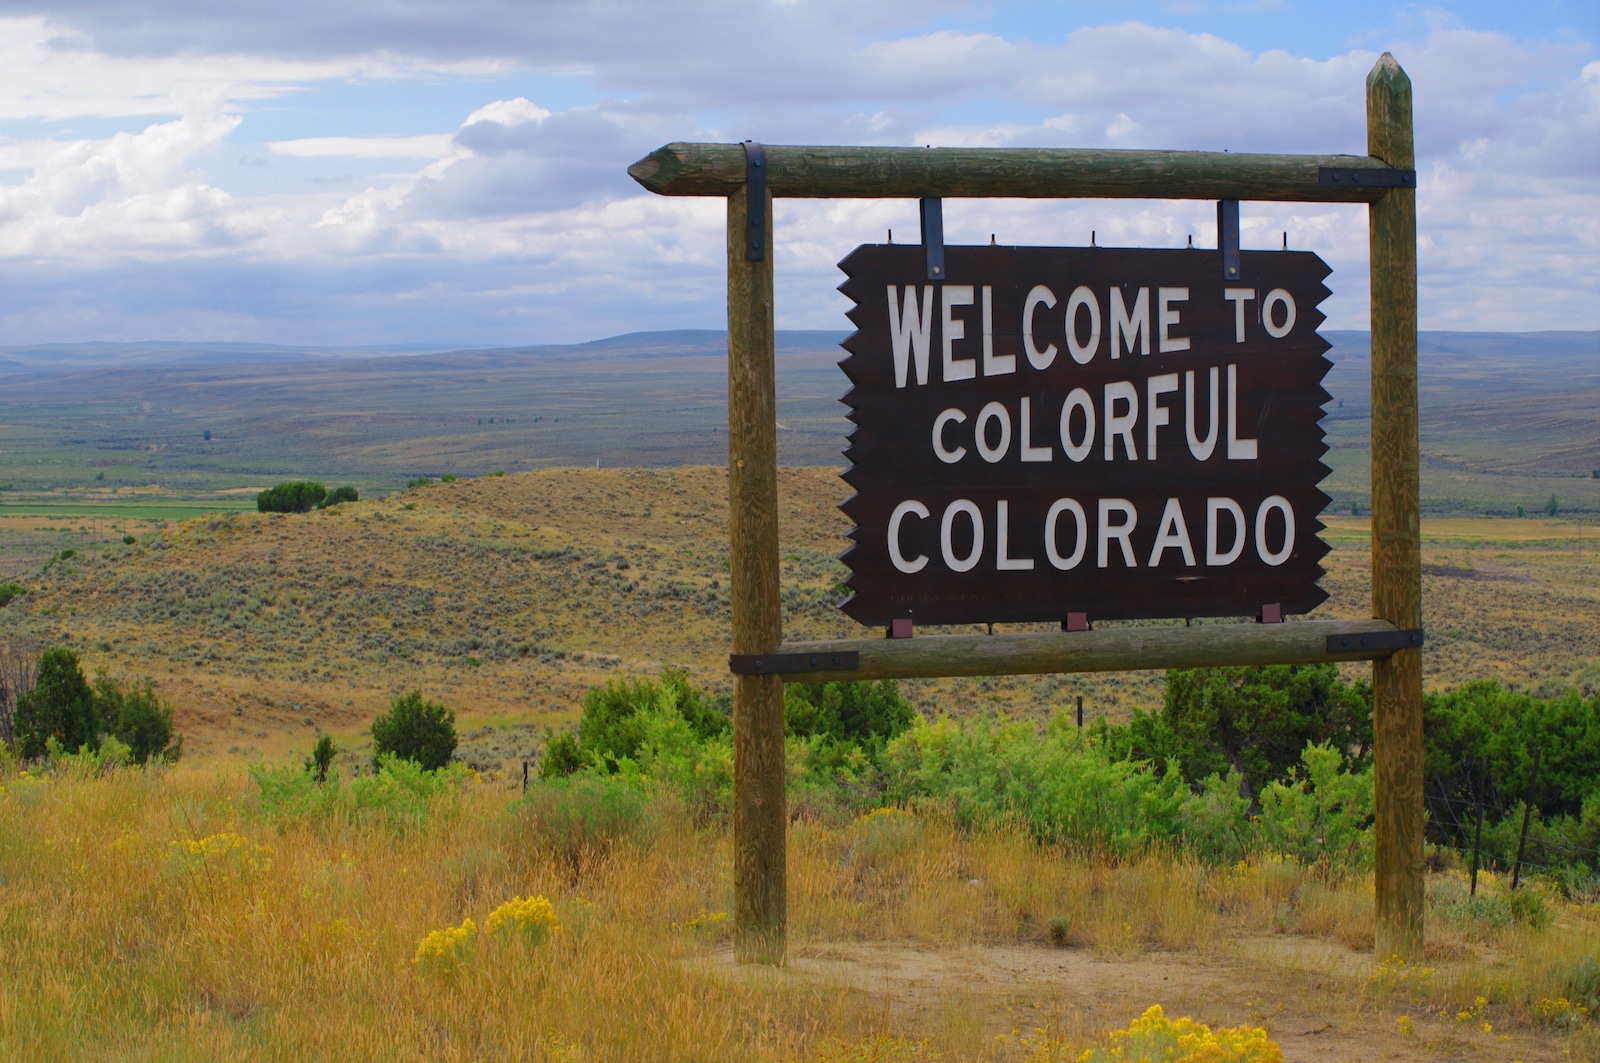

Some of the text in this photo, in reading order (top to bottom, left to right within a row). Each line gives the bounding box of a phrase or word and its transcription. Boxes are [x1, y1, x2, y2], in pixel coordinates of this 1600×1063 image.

[887, 285, 1297, 388] WELCOME TO
[932, 364, 1258, 464] COLORFUL
[887, 495, 1296, 574] COLORADO
